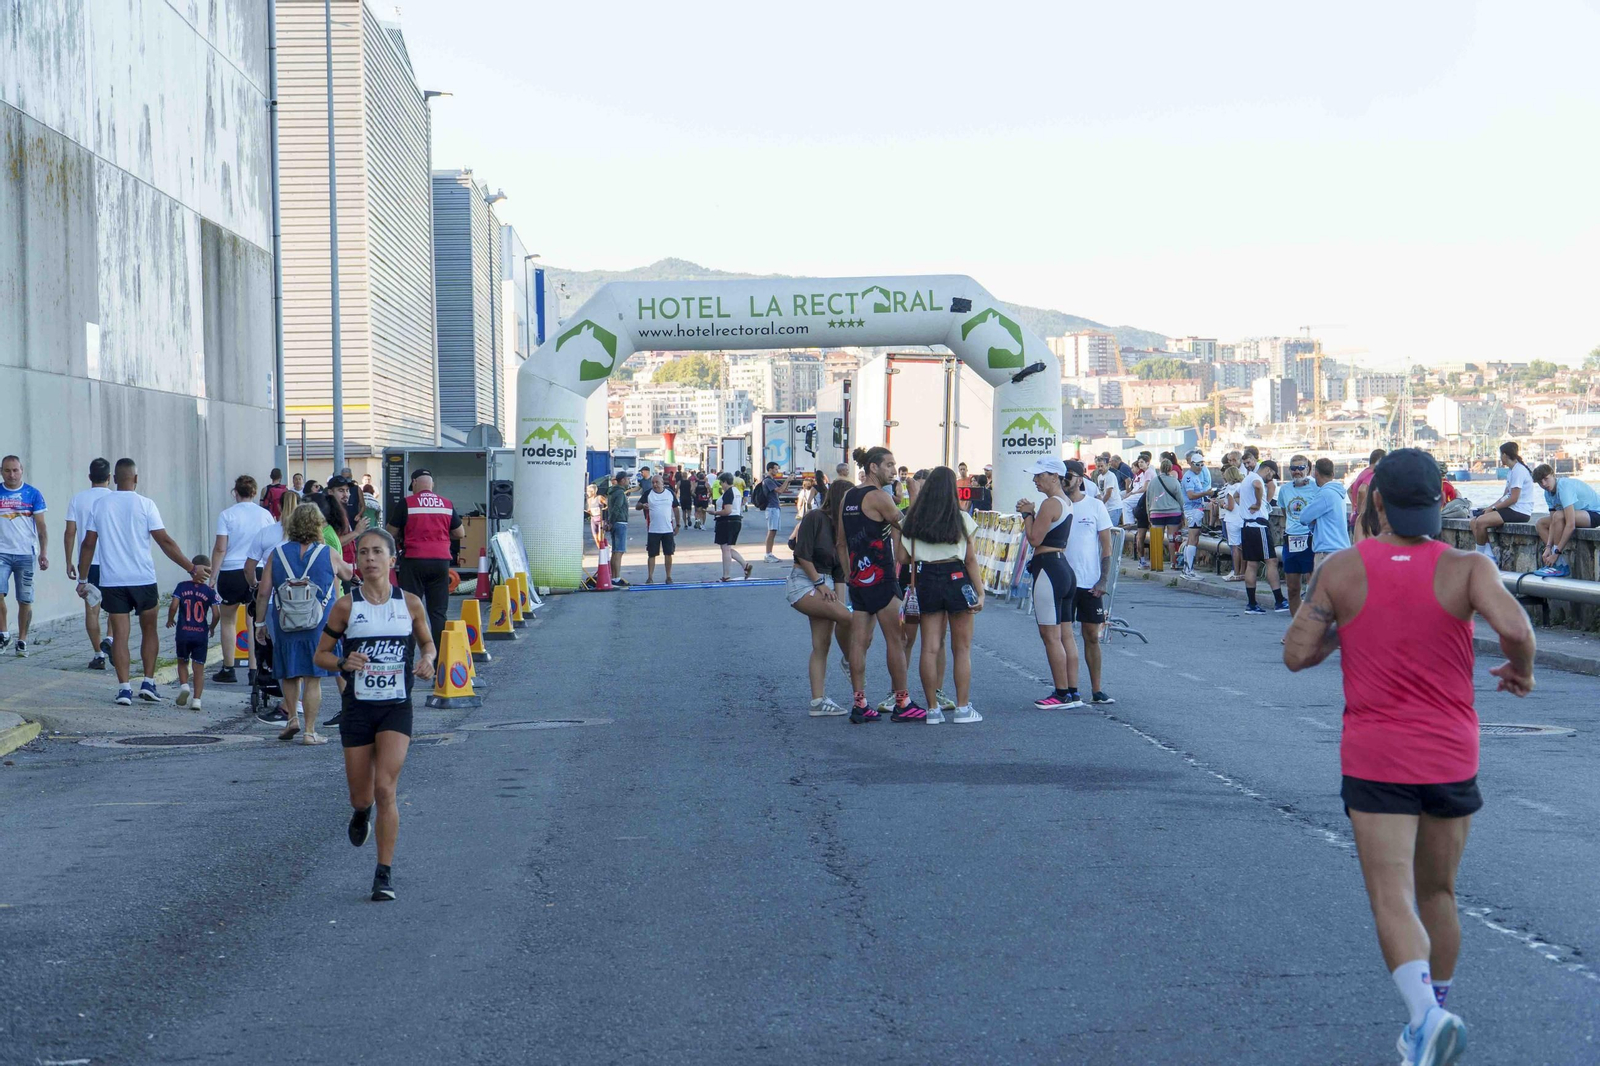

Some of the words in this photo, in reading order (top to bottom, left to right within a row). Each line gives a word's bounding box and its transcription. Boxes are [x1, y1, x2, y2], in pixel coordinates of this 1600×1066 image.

[638, 296, 731, 320] HOTEL
[750, 294, 783, 317] LA
[638, 321, 809, 337] www.hotelrectoral.com
[1002, 433, 1056, 450] rodespi
[522, 443, 577, 461] rodespi
[417, 497, 445, 508] VODEA
[184, 599, 204, 623] 10
[364, 674, 397, 689] 664
